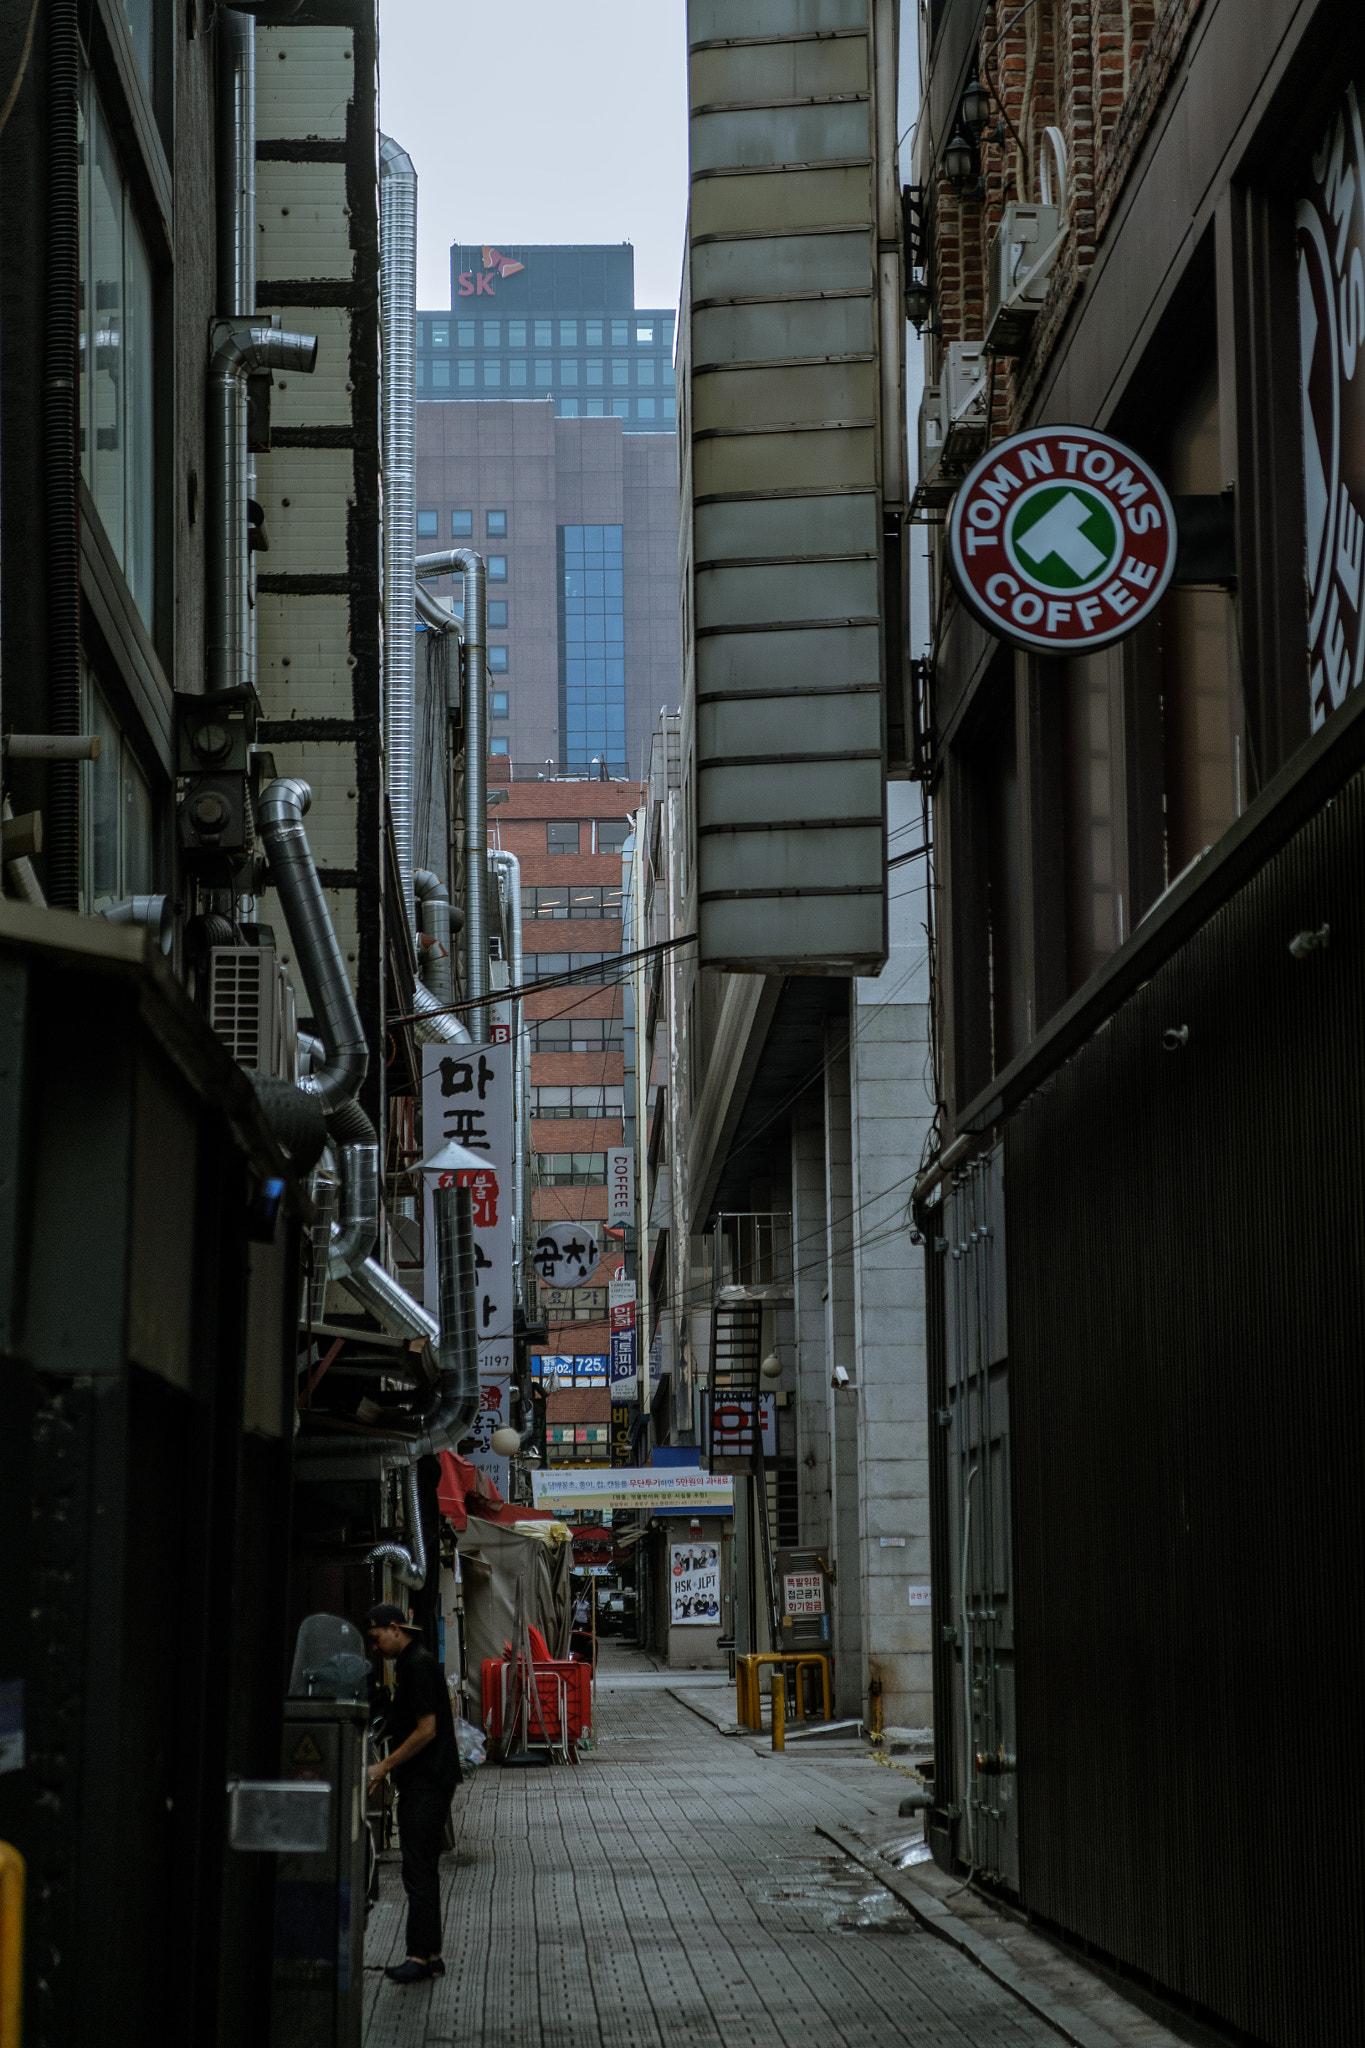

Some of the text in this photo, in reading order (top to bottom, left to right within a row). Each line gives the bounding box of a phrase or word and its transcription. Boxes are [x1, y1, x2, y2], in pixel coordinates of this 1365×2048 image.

[458, 272, 495, 296] SK
[965, 441, 1161, 557] TOM N TOMS
[985, 556, 1158, 632] COFFEE
[439, 1054, 495, 1150] 마포
[614, 1156, 628, 1208] COFFEE
[534, 1237, 598, 1278] 곱창
[576, 1357, 605, 1372] 725.
[676, 1477, 704, 1488] 5만원의
[674, 1579, 692, 1594] HSK
[697, 1575, 717, 1590] JLPT
[787, 1576, 821, 1588] 폭발위험
[787, 1589, 822, 1600] 접근금지
[911, 1592, 931, 1600] 금연구
[788, 1601, 822, 1612] 화기엄금
